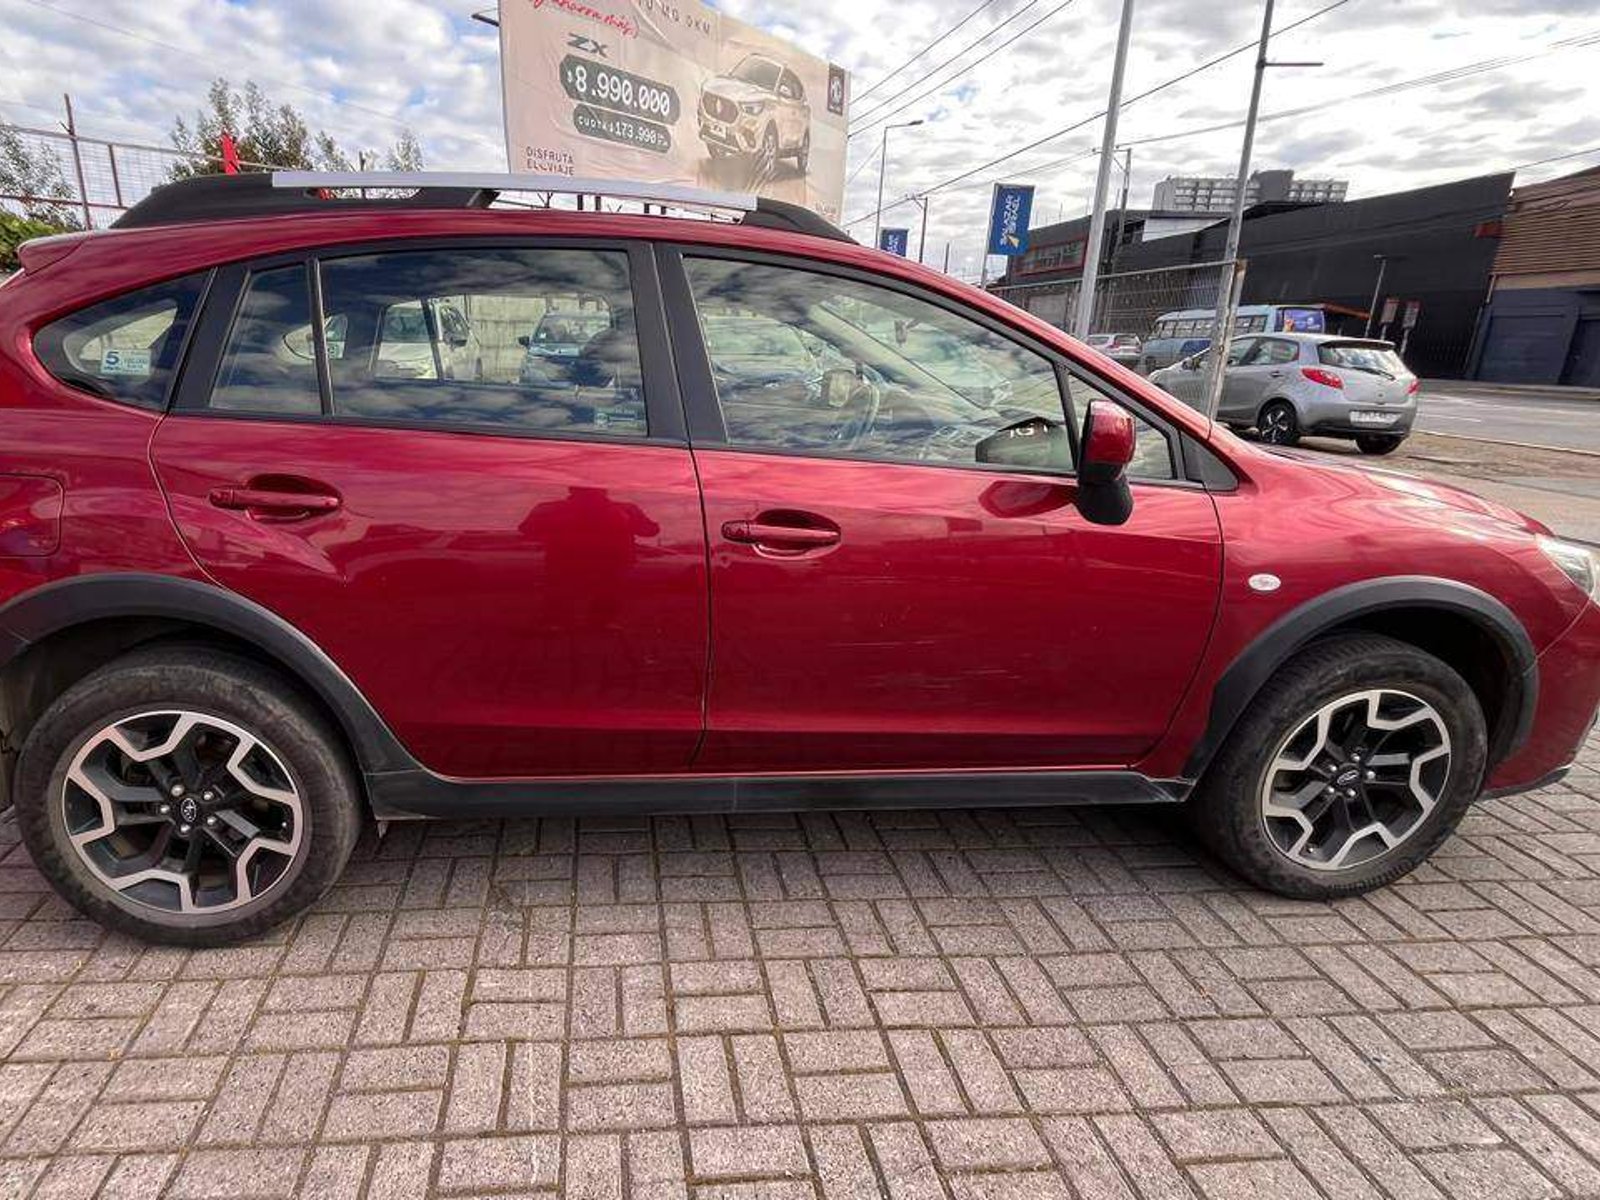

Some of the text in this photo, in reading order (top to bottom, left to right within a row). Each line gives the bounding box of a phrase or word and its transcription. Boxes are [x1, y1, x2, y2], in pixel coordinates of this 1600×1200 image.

[567, 32, 608, 57] ZX
[526, 145, 574, 164] DISFRUTA
[547, 162, 575, 176] VIAJE
[105, 351, 119, 365] 5
